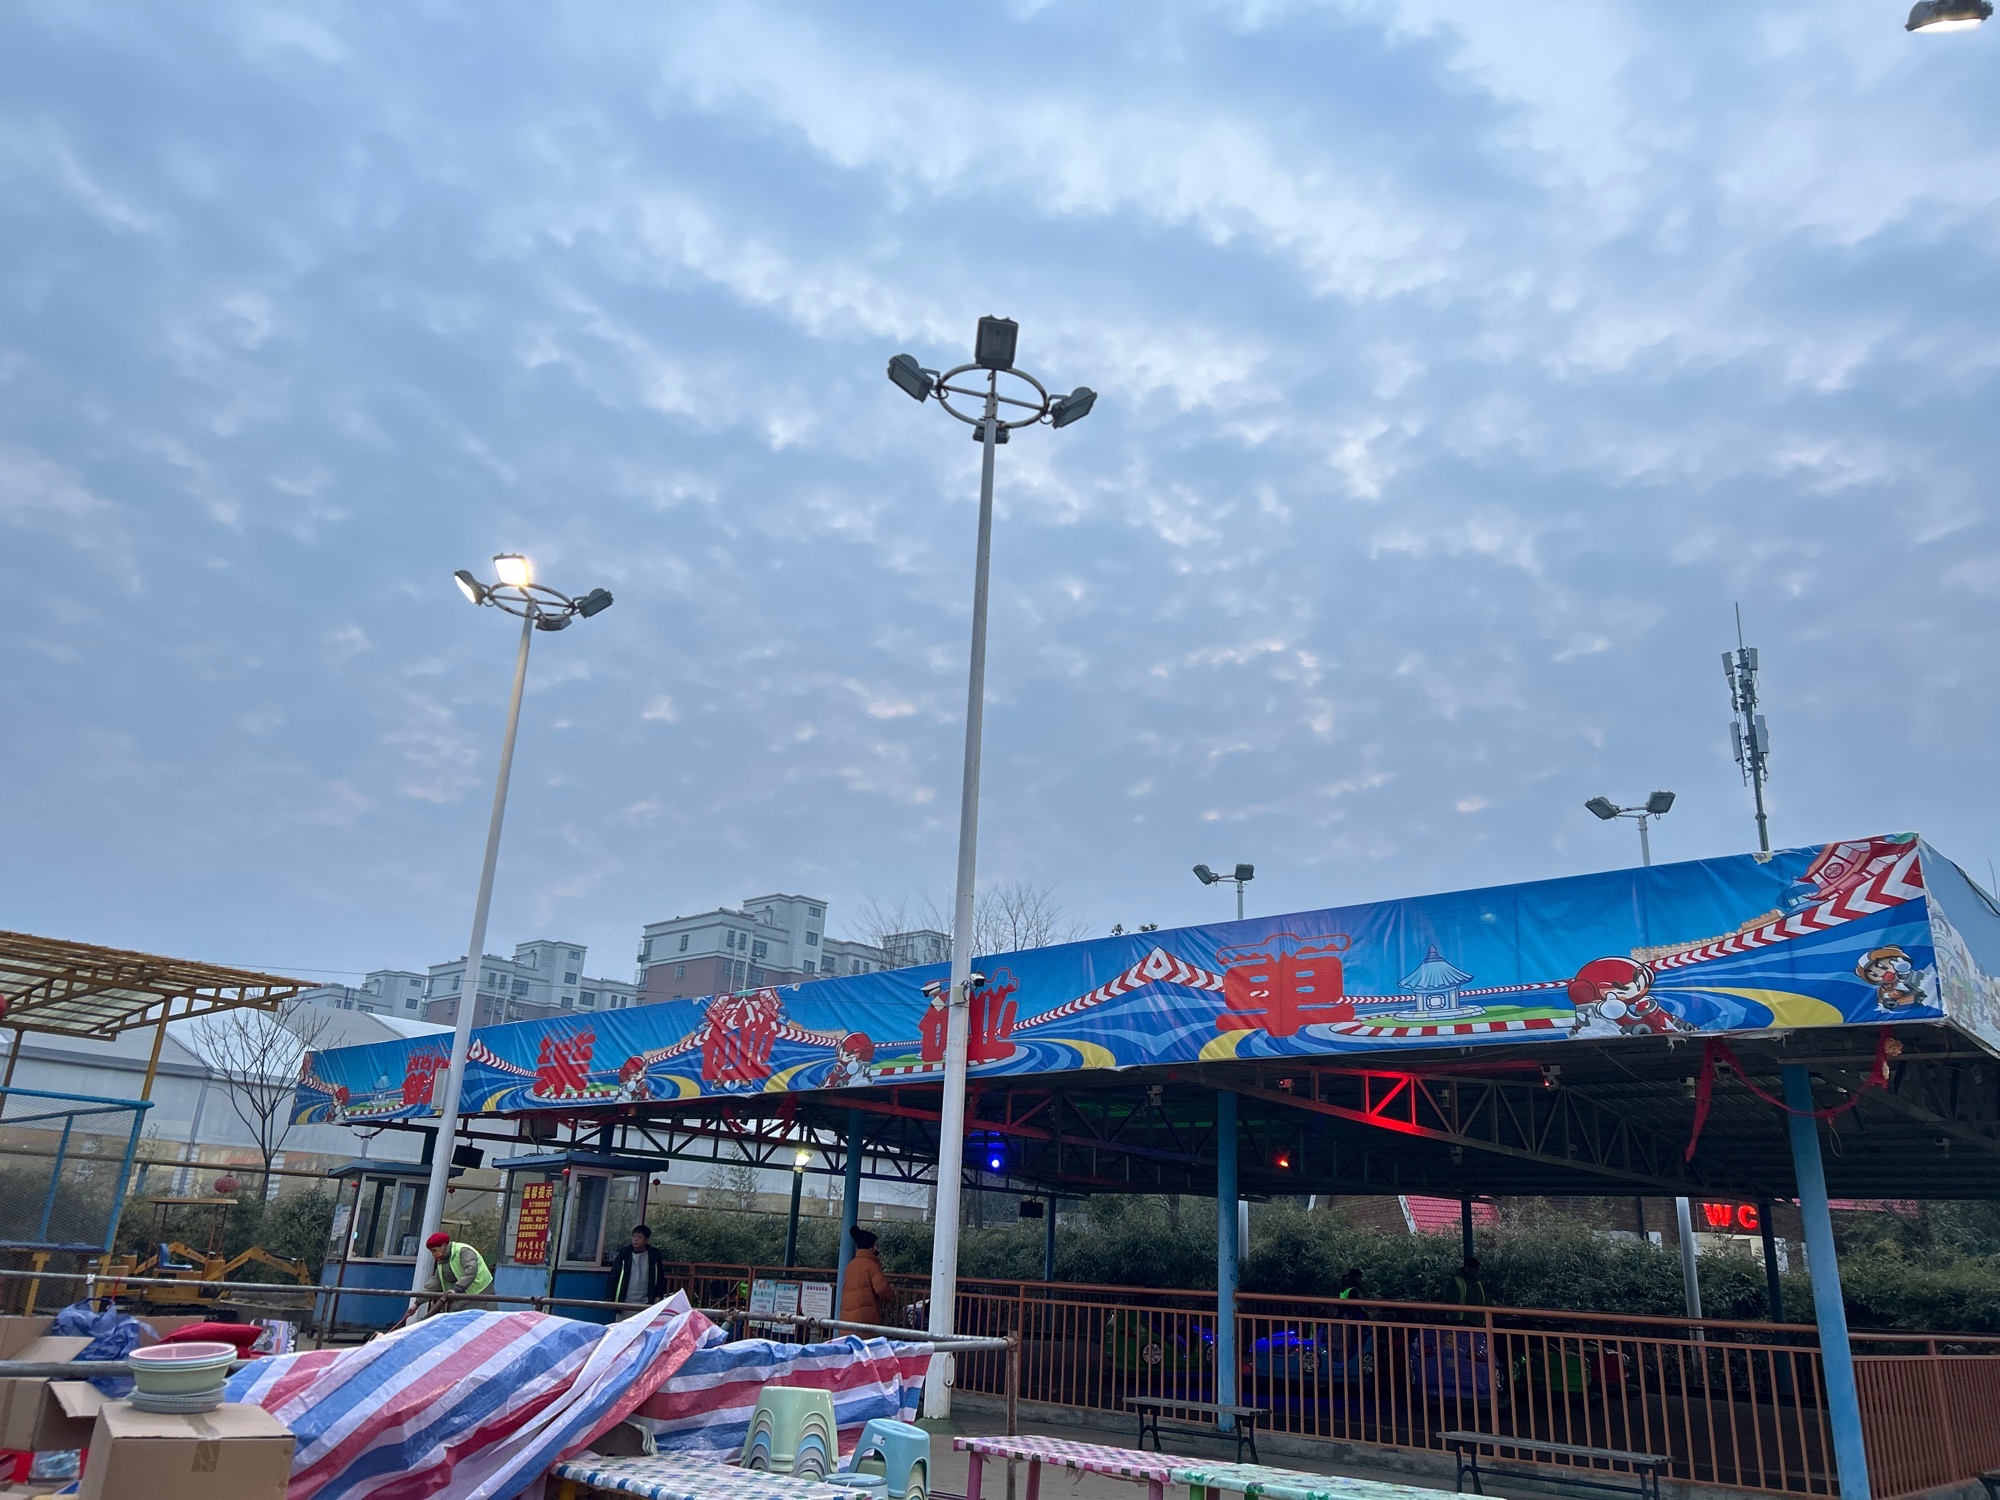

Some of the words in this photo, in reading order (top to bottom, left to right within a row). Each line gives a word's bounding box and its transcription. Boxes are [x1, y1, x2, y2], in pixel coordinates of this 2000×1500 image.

[523, 1186, 553, 1199] 温馨提示
[1703, 1203, 1758, 1229] WC
